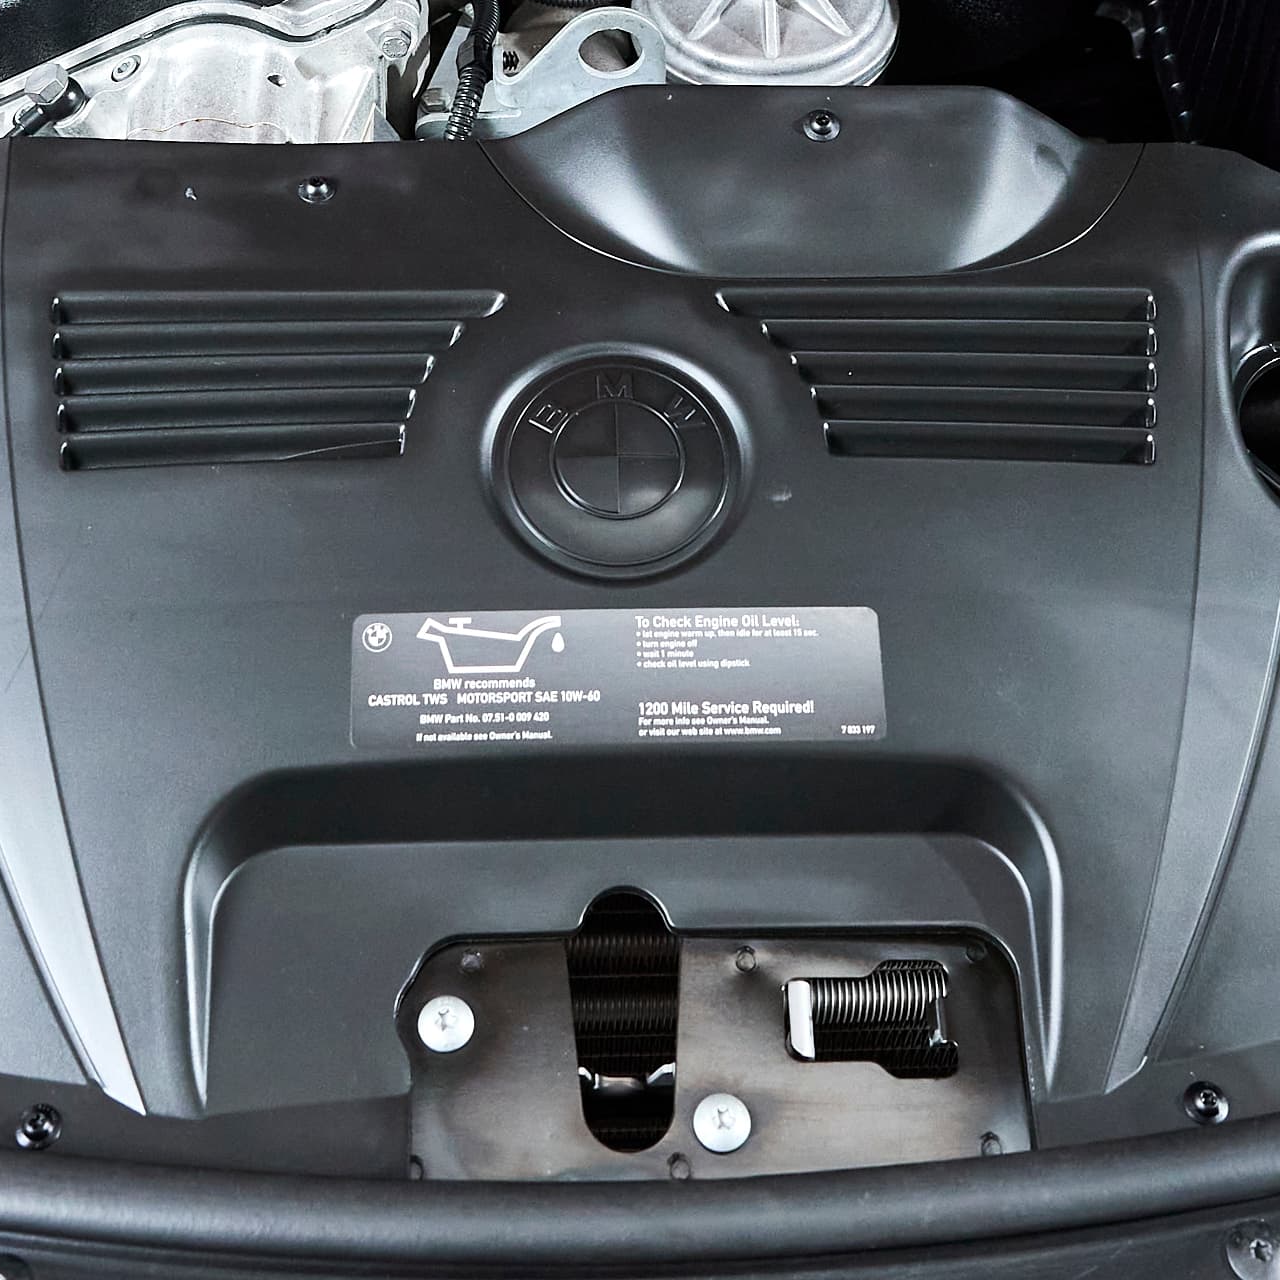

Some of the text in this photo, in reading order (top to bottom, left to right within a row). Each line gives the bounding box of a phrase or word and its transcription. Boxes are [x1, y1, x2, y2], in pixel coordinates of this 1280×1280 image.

[528, 374, 706, 433] BMW
[635, 614, 800, 630] To Check Engine Oil Level:
[654, 631, 679, 640] engine
[793, 629, 802, 637] 15
[643, 640, 659, 648] turn
[660, 640, 686, 649] engine
[643, 650, 660, 658] wait
[667, 650, 694, 658] minute
[643, 658, 751, 669] check oil level using dipstick
[433, 677, 536, 690] BMW recommends
[368, 690, 600, 707] CASTROL TWS MOTORSPORT SAE 10W-60
[638, 700, 815, 717] 1200 Mile Service Required!
[420, 713, 444, 725] BMW
[445, 713, 463, 723] Part
[465, 713, 480, 723] No.
[638, 717, 651, 726] For
[653, 718, 673, 726] more
[675, 716, 690, 725] info
[691, 717, 705, 725] see
[707, 716, 738, 725] Owner's
[423, 733, 437, 742] not
[438, 731, 472, 742] available
[474, 732, 488, 741] see
[489, 731, 520, 741] Owner's
[638, 727, 782, 736] or visit our web site at www.bmw.com
